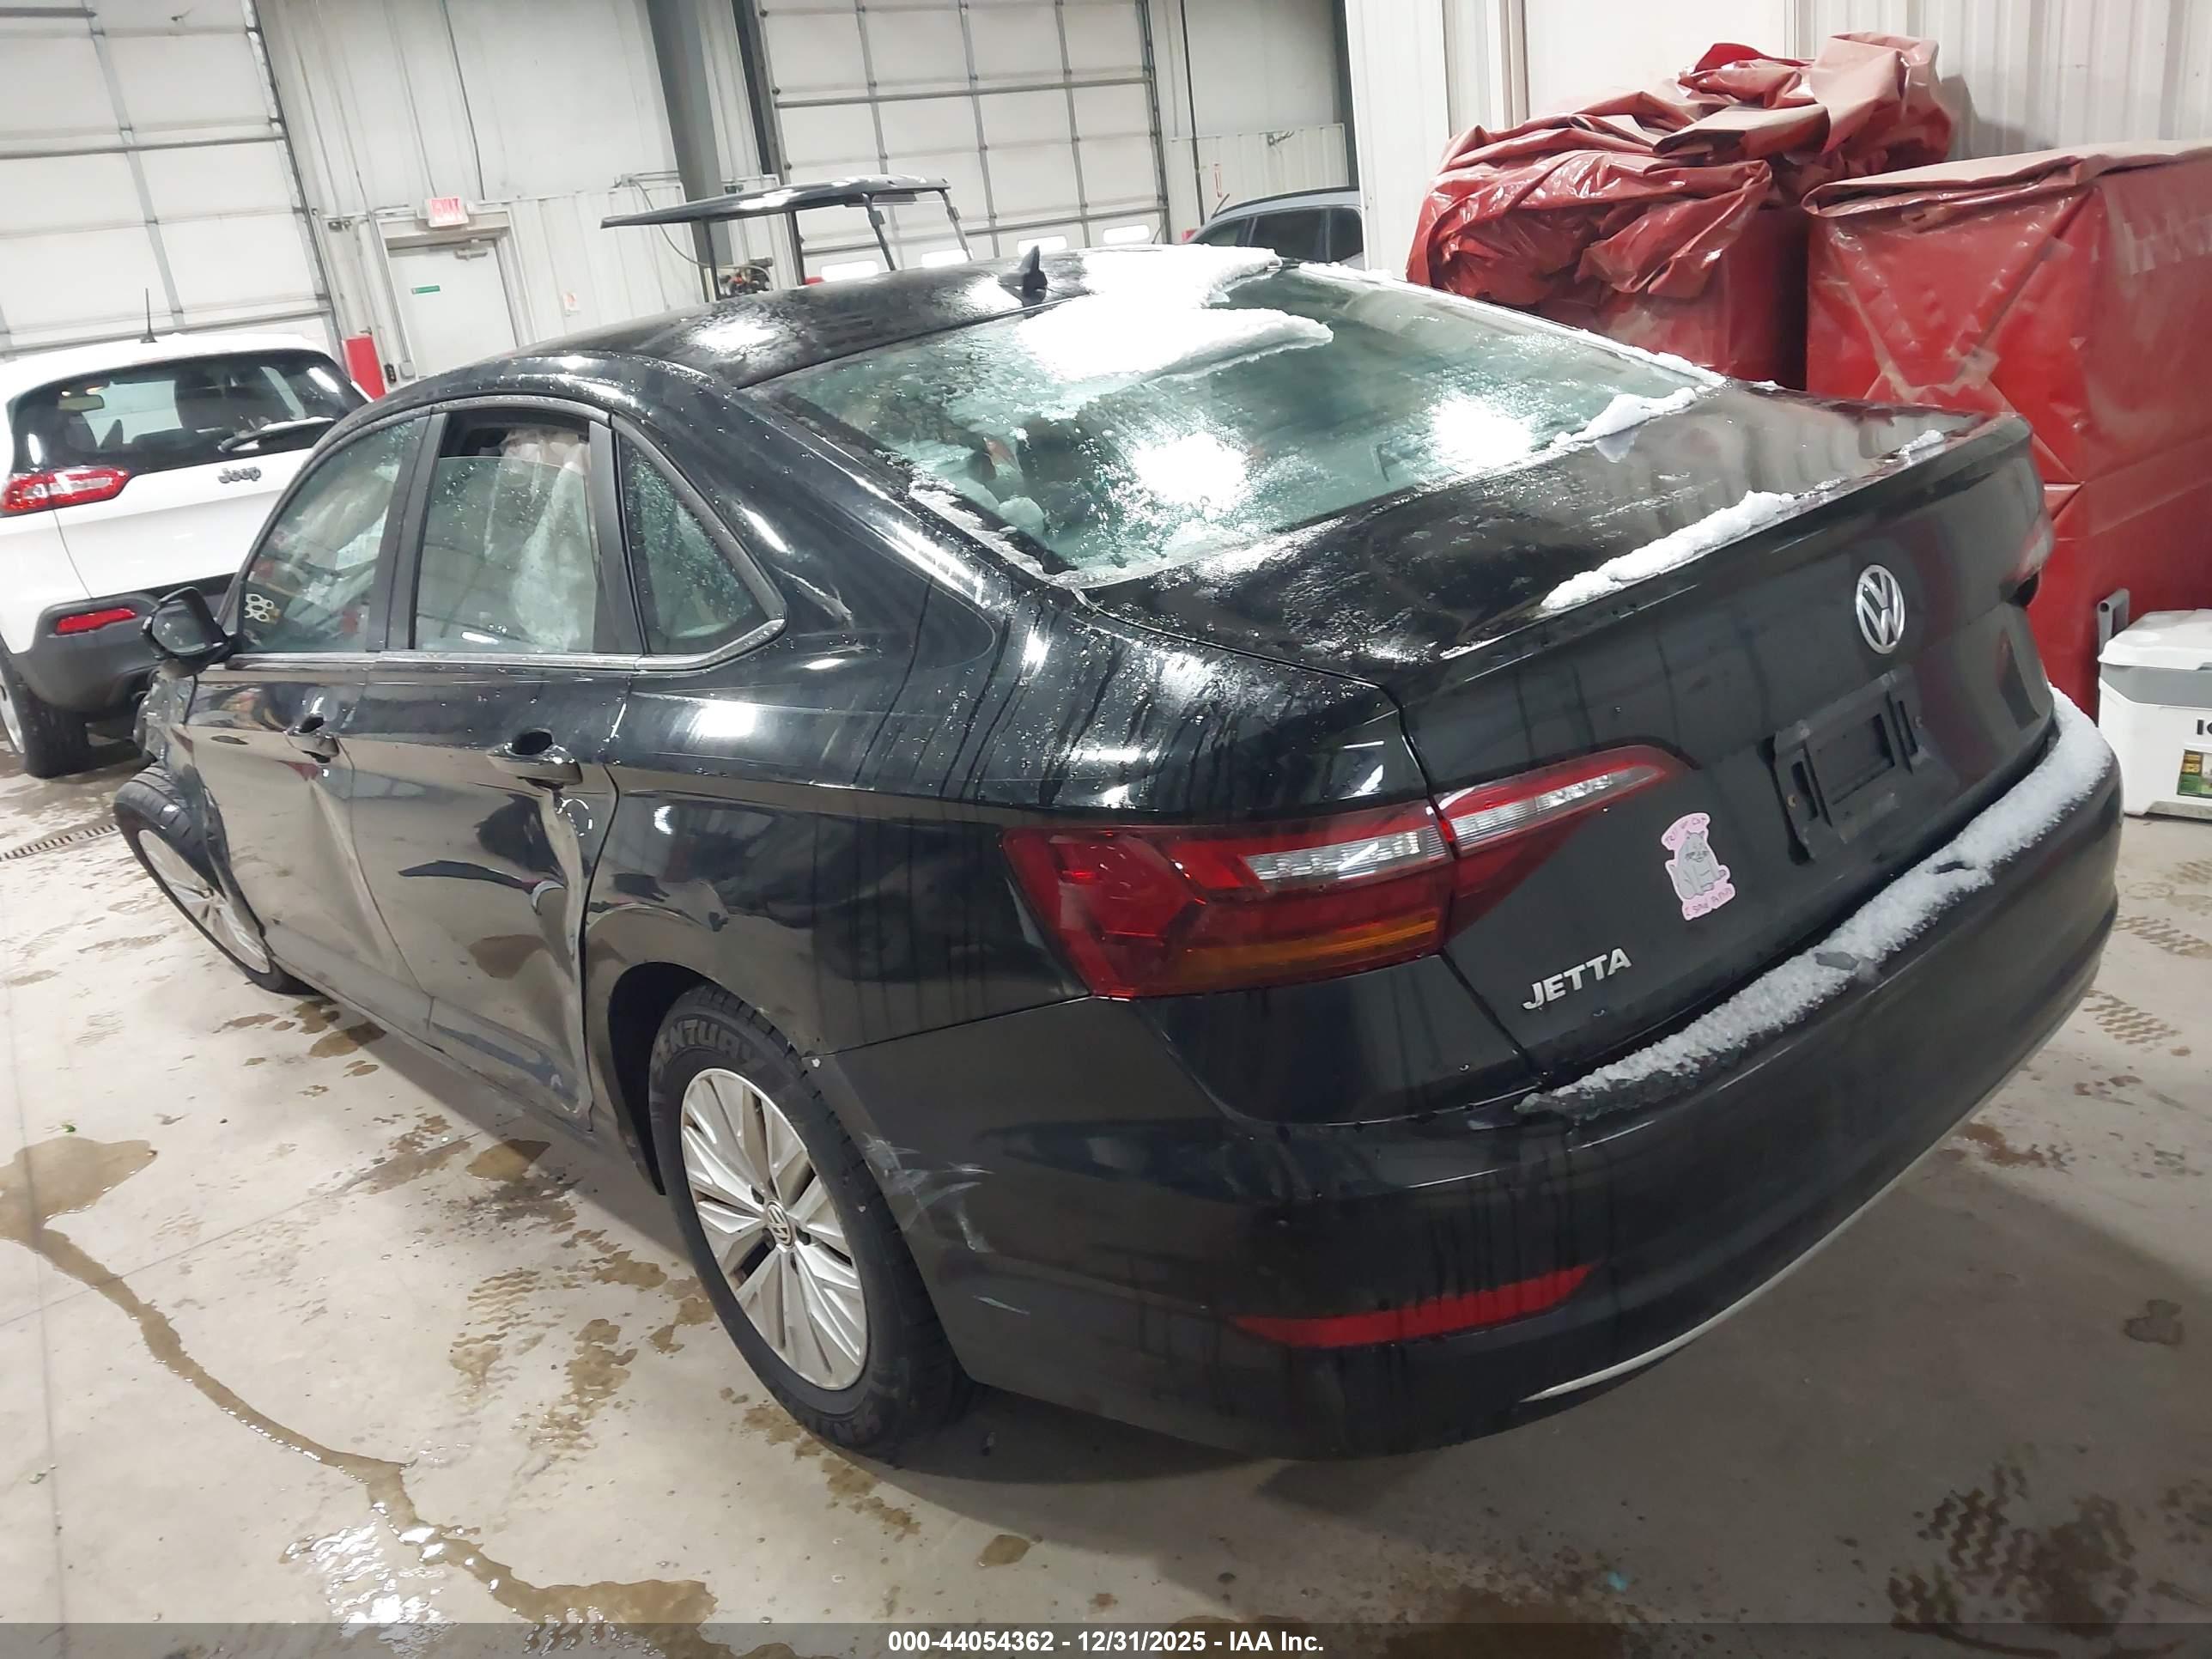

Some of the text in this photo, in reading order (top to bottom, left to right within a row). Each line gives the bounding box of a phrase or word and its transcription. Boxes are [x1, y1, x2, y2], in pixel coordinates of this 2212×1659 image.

[217, 467, 261, 483] Jeep
[1856, 564, 1905, 653] VW
[1522, 947, 1632, 1010] JETTA
